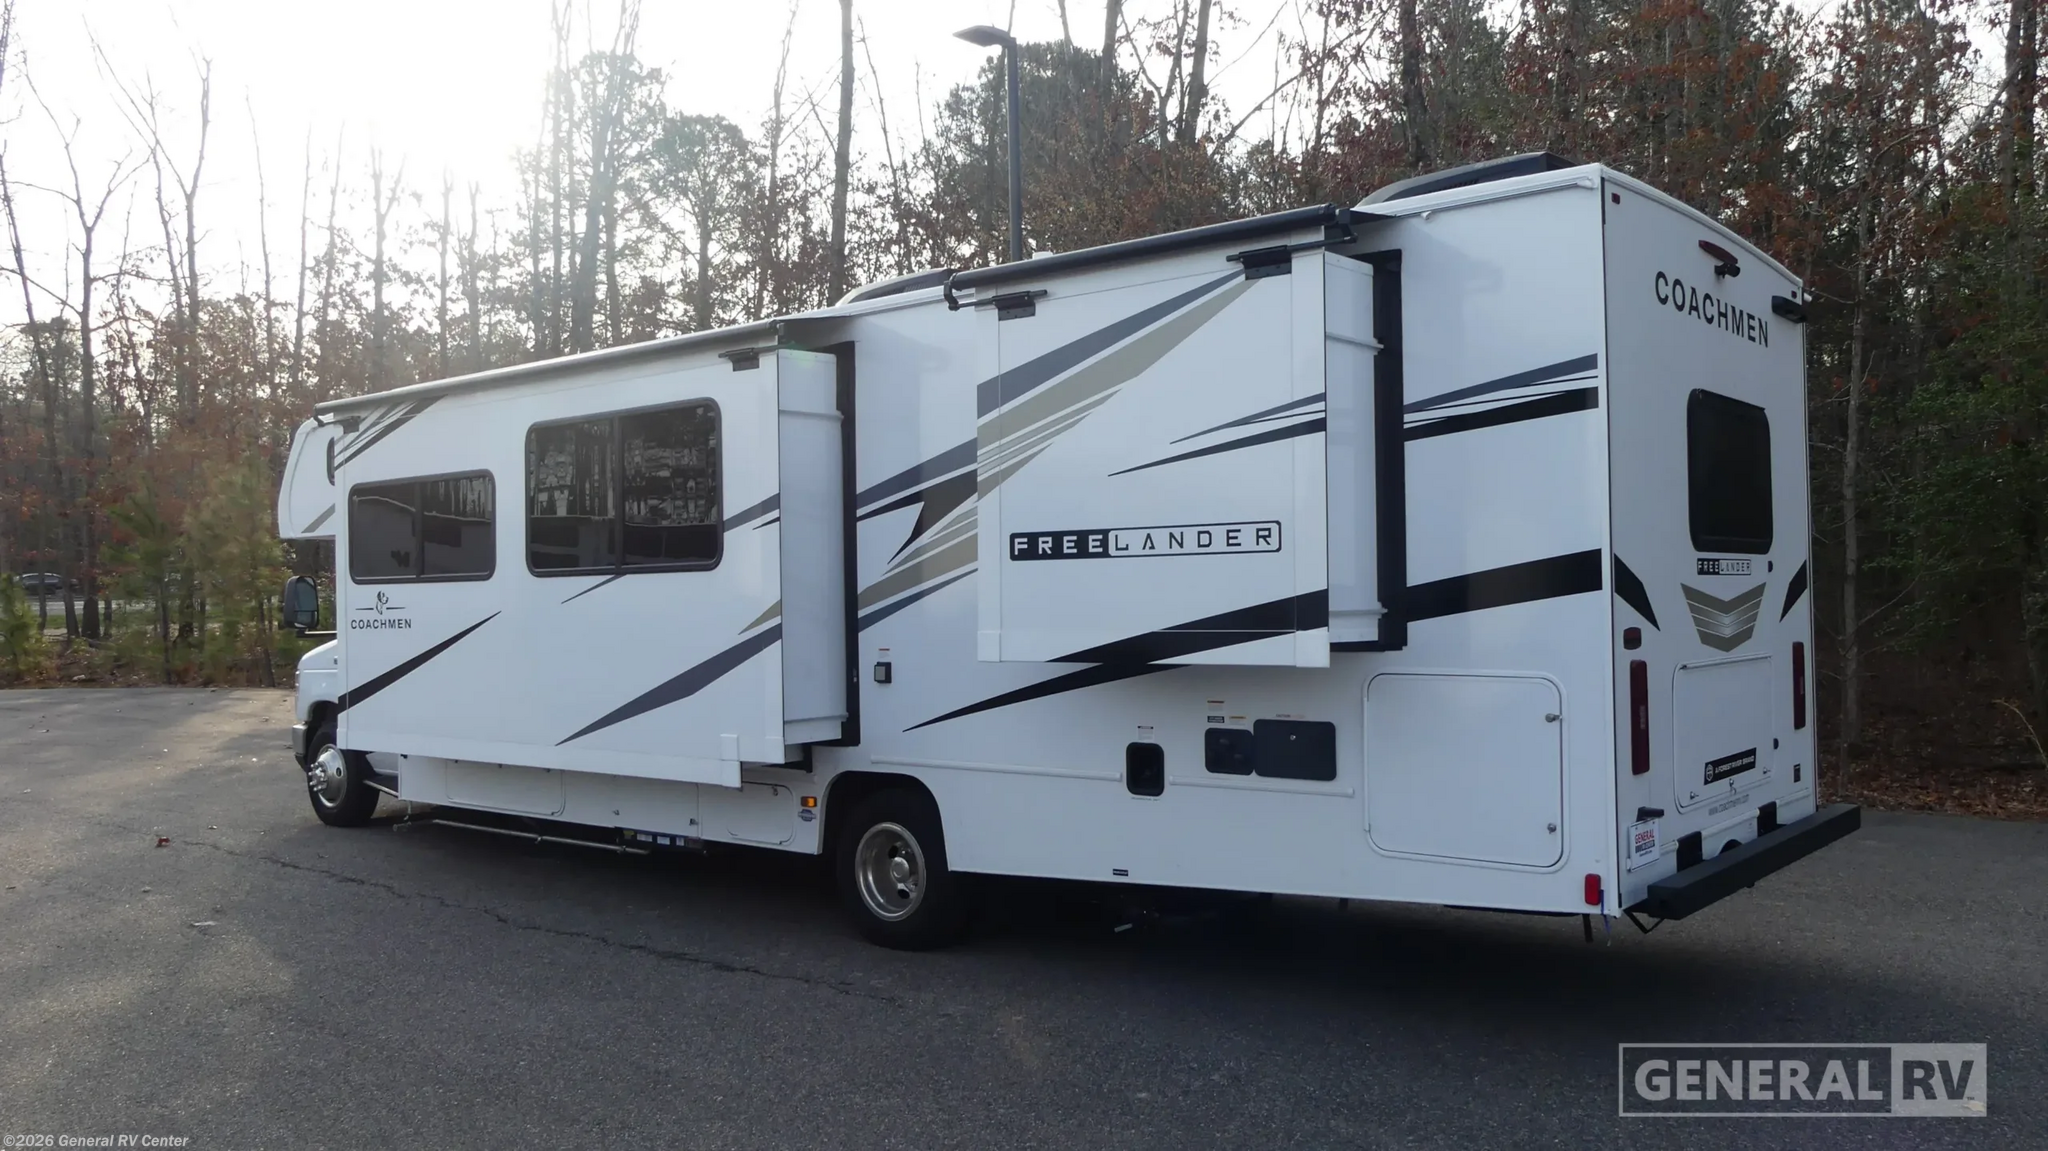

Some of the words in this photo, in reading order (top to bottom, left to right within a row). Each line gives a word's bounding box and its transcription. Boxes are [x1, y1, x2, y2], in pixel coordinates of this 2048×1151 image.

[1655, 270, 1769, 348] COACHMEN
[1013, 527, 1272, 556] FREELANDER
[351, 618, 412, 630] COACHMEN
[1635, 829, 1655, 845] GENERAL
